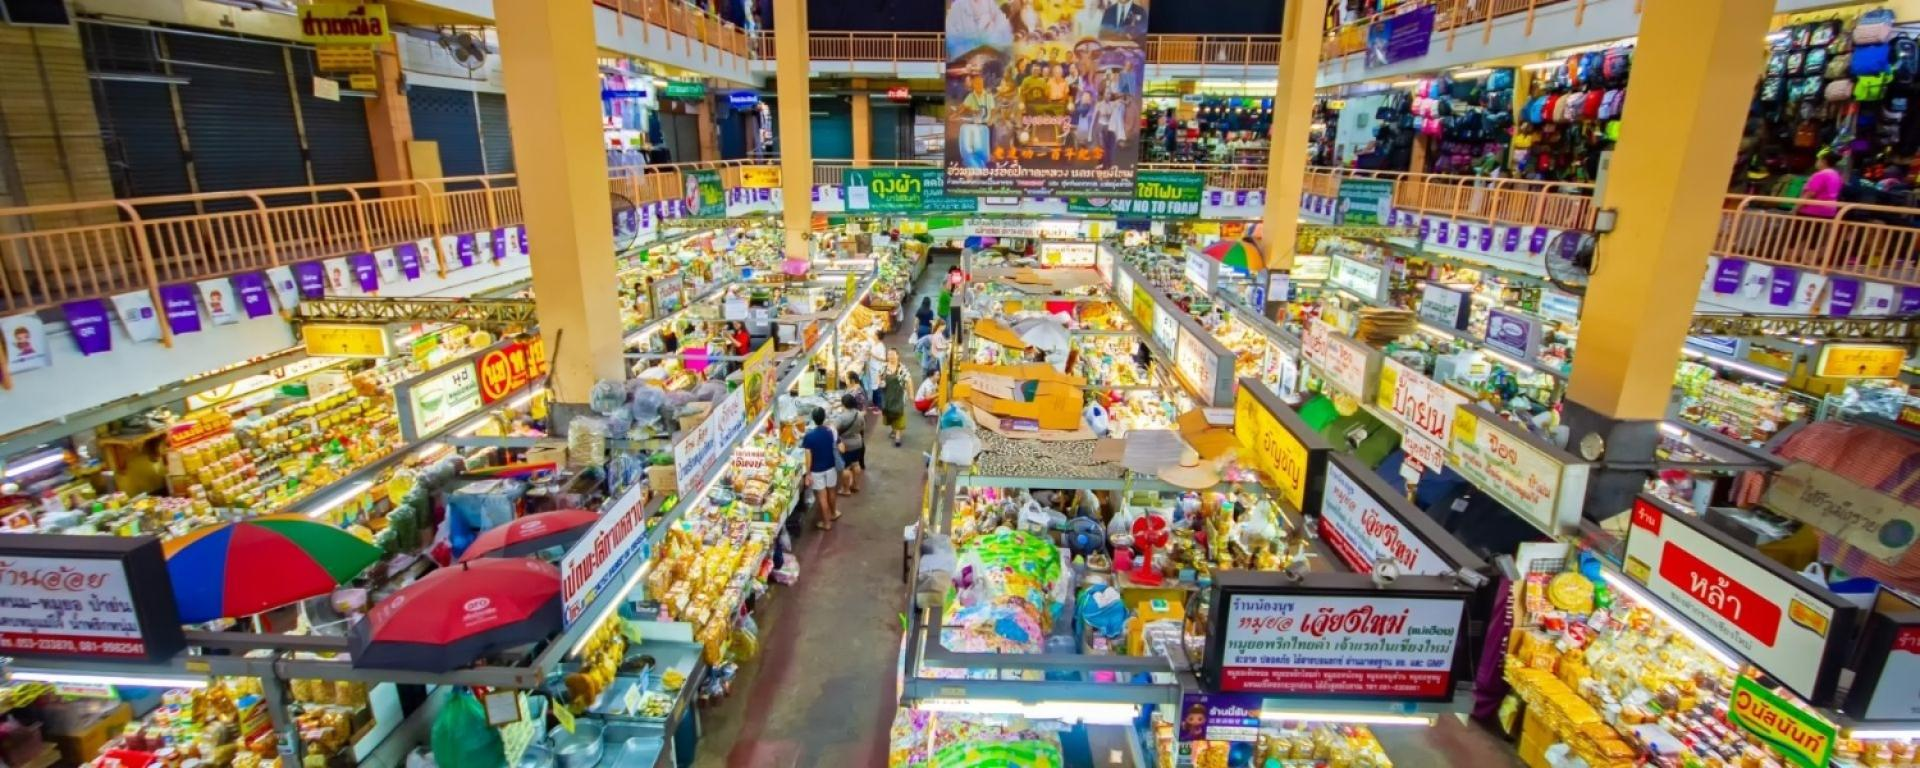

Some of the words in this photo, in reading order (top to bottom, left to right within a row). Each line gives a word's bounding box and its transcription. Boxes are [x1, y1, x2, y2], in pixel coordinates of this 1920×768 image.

[872, 173, 921, 199] ถุงผ้า
[1138, 182, 1183, 199] ใช้โฟม
[1110, 199, 1131, 212] SAY
[1132, 200, 1149, 213] NO
[1151, 201, 1165, 213] TO
[1167, 202, 1199, 214] FOAM
[79, 326, 96, 337] QR
[1263, 430, 1300, 489] อัญชัญ
[1638, 506, 1656, 527] ร้าน
[1690, 571, 1742, 620] หล้า
[1233, 598, 1294, 615] ร้านน้องนุช
[1228, 636, 1331, 654] หมูยอพริกไทยดำ
[1334, 636, 1452, 653] เจ้าแรกในเชียงใหม่
[1898, 633, 1920, 647] ร้า
[1426, 659, 1446, 668] GMP
[1736, 691, 1825, 753] วนัสนันท์
